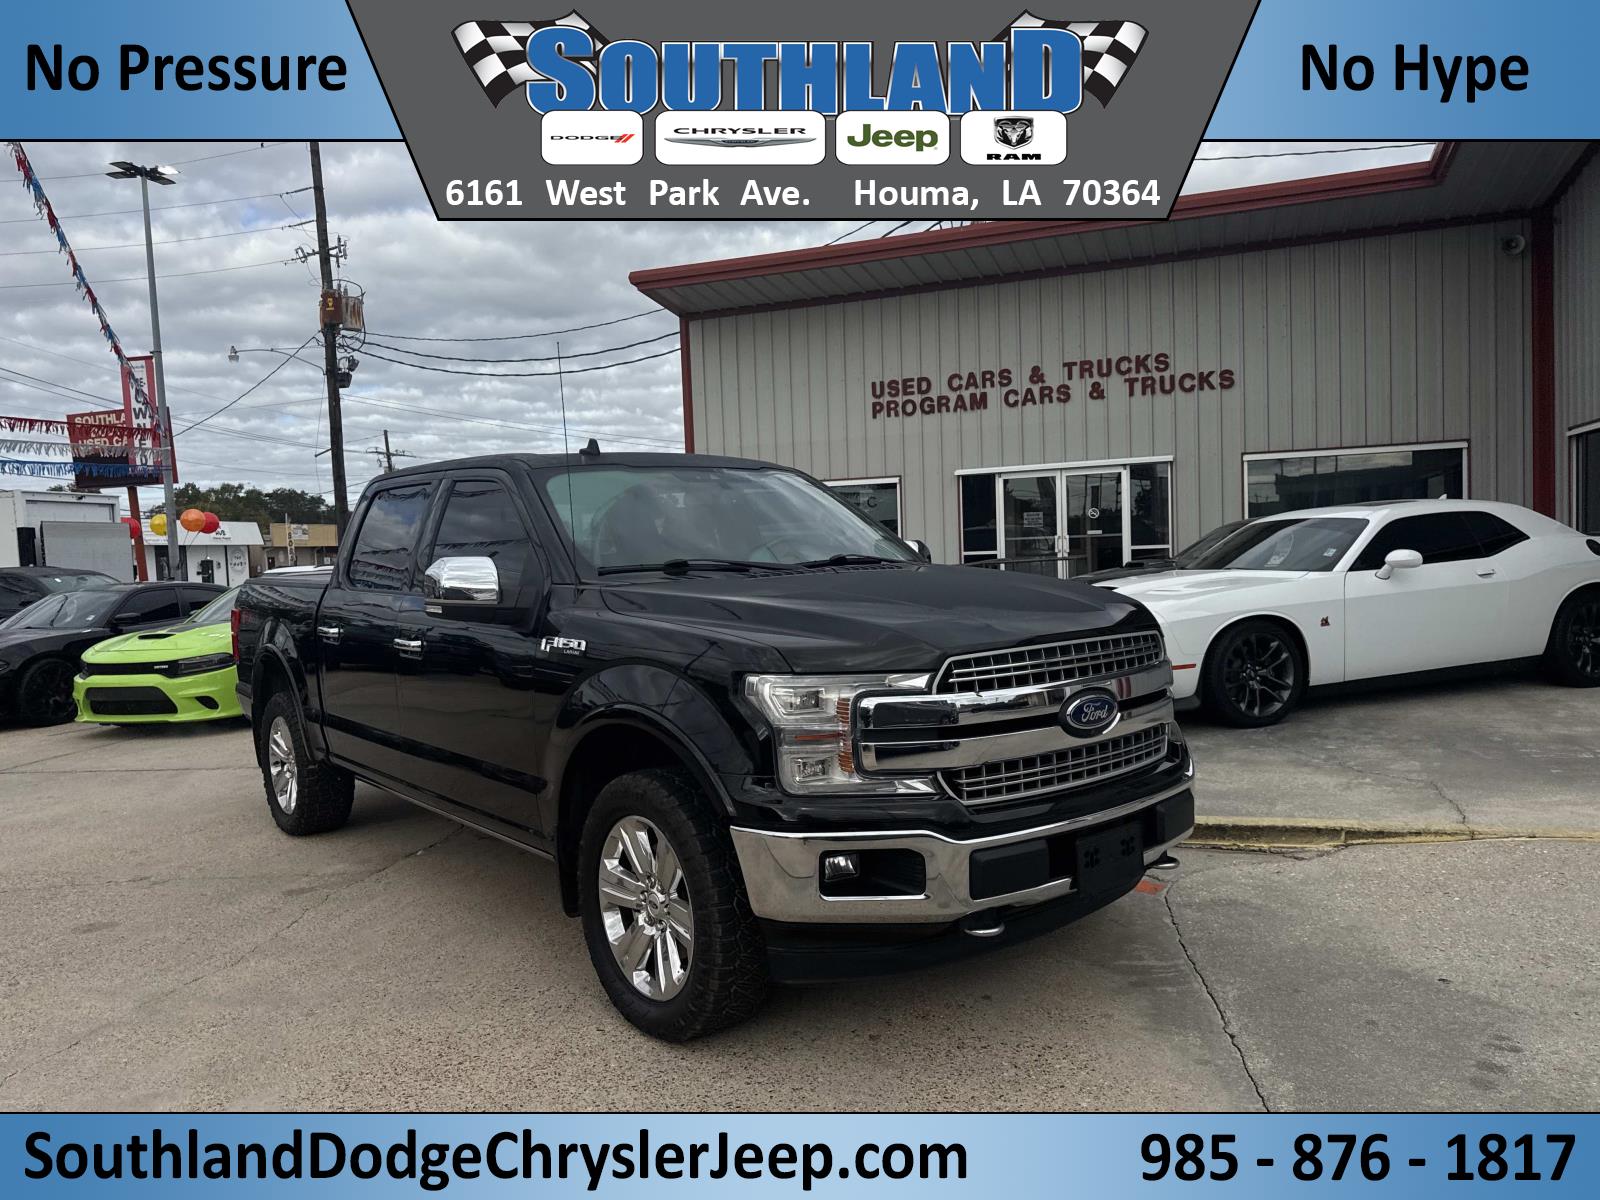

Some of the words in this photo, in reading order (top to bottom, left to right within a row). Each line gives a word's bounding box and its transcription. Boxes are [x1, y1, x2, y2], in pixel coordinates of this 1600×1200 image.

[871, 376, 932, 399] USED
[947, 368, 1013, 392] CARS
[1029, 365, 1046, 385] &
[1062, 352, 1170, 381] TRUCKS
[872, 392, 988, 419] PROGRAM
[1003, 383, 1071, 408] CARS
[1088, 381, 1106, 400] &
[1123, 369, 1235, 397] TRUCKS
[1081, 702, 1109, 722] Ford
